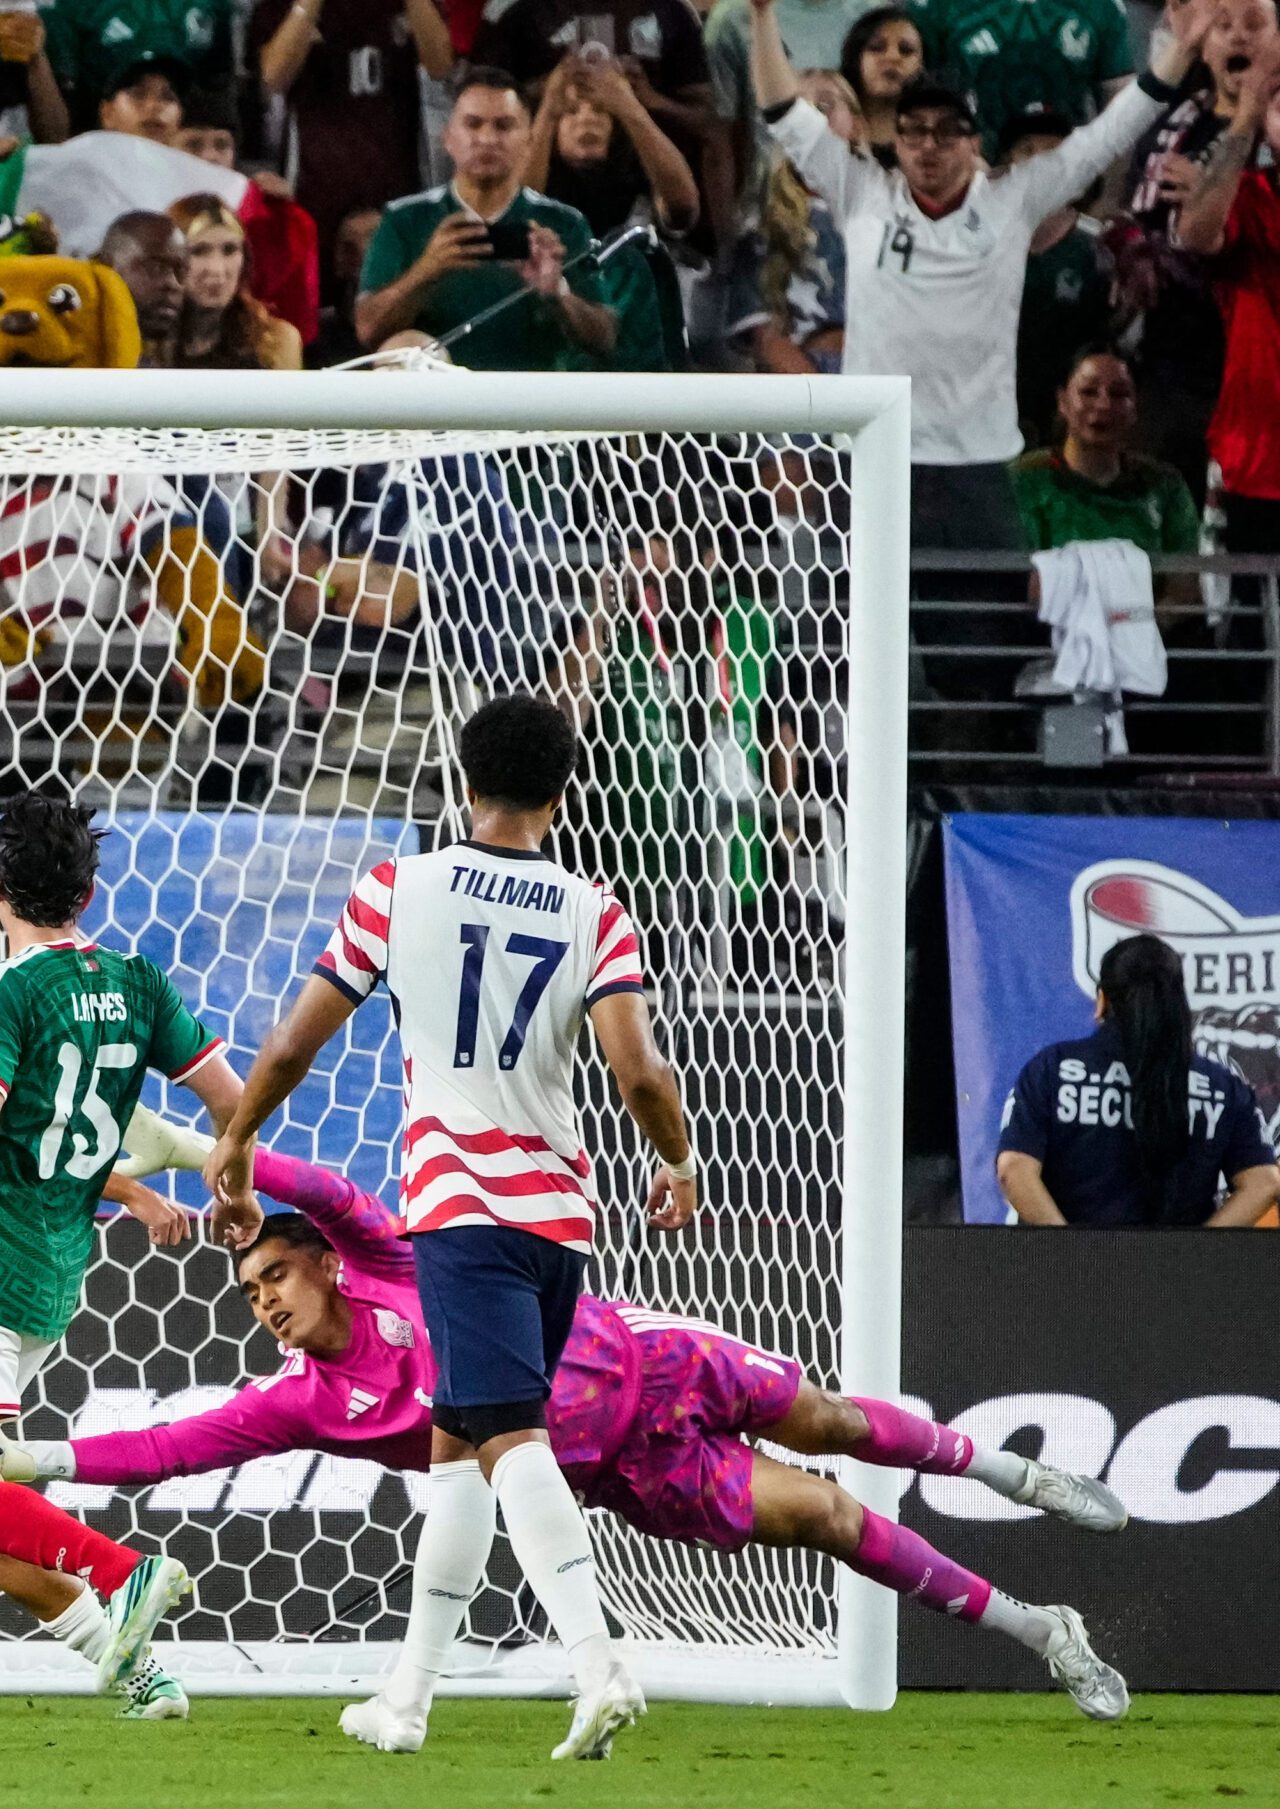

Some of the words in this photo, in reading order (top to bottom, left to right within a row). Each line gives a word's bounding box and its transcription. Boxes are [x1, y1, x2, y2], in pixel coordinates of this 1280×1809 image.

[876, 219, 915, 274] 19
[451, 866, 566, 914] TILLMAN
[453, 922, 571, 1072] 17
[38, 1041, 137, 1181] 15
[1057, 1085, 1226, 1140] SECTY
[901, 1392, 1280, 1526] oc
